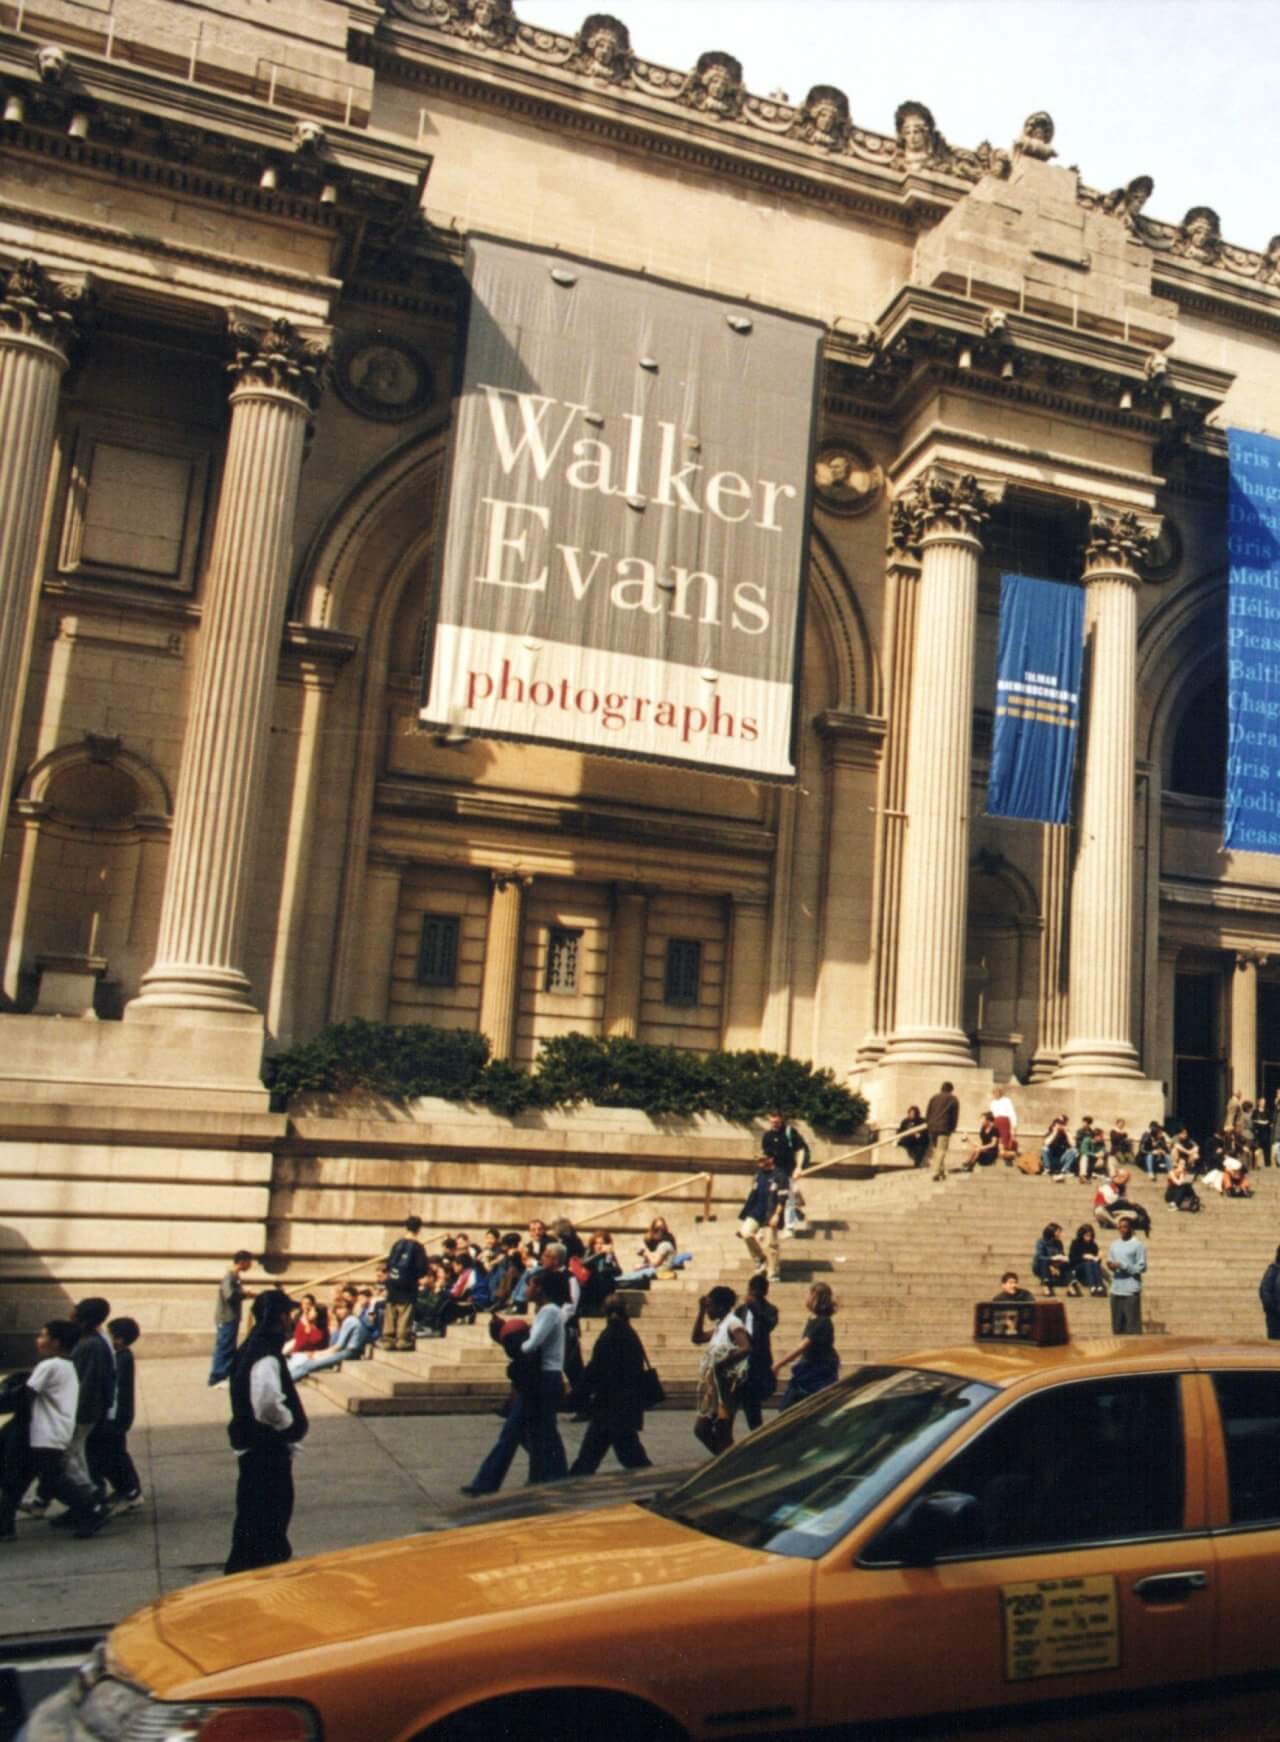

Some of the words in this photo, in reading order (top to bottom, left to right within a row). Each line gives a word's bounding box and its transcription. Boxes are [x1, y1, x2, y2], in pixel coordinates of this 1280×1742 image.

[477, 383, 796, 531] Walker
[474, 497, 769, 635] Evans
[467, 659, 760, 743] photographs
